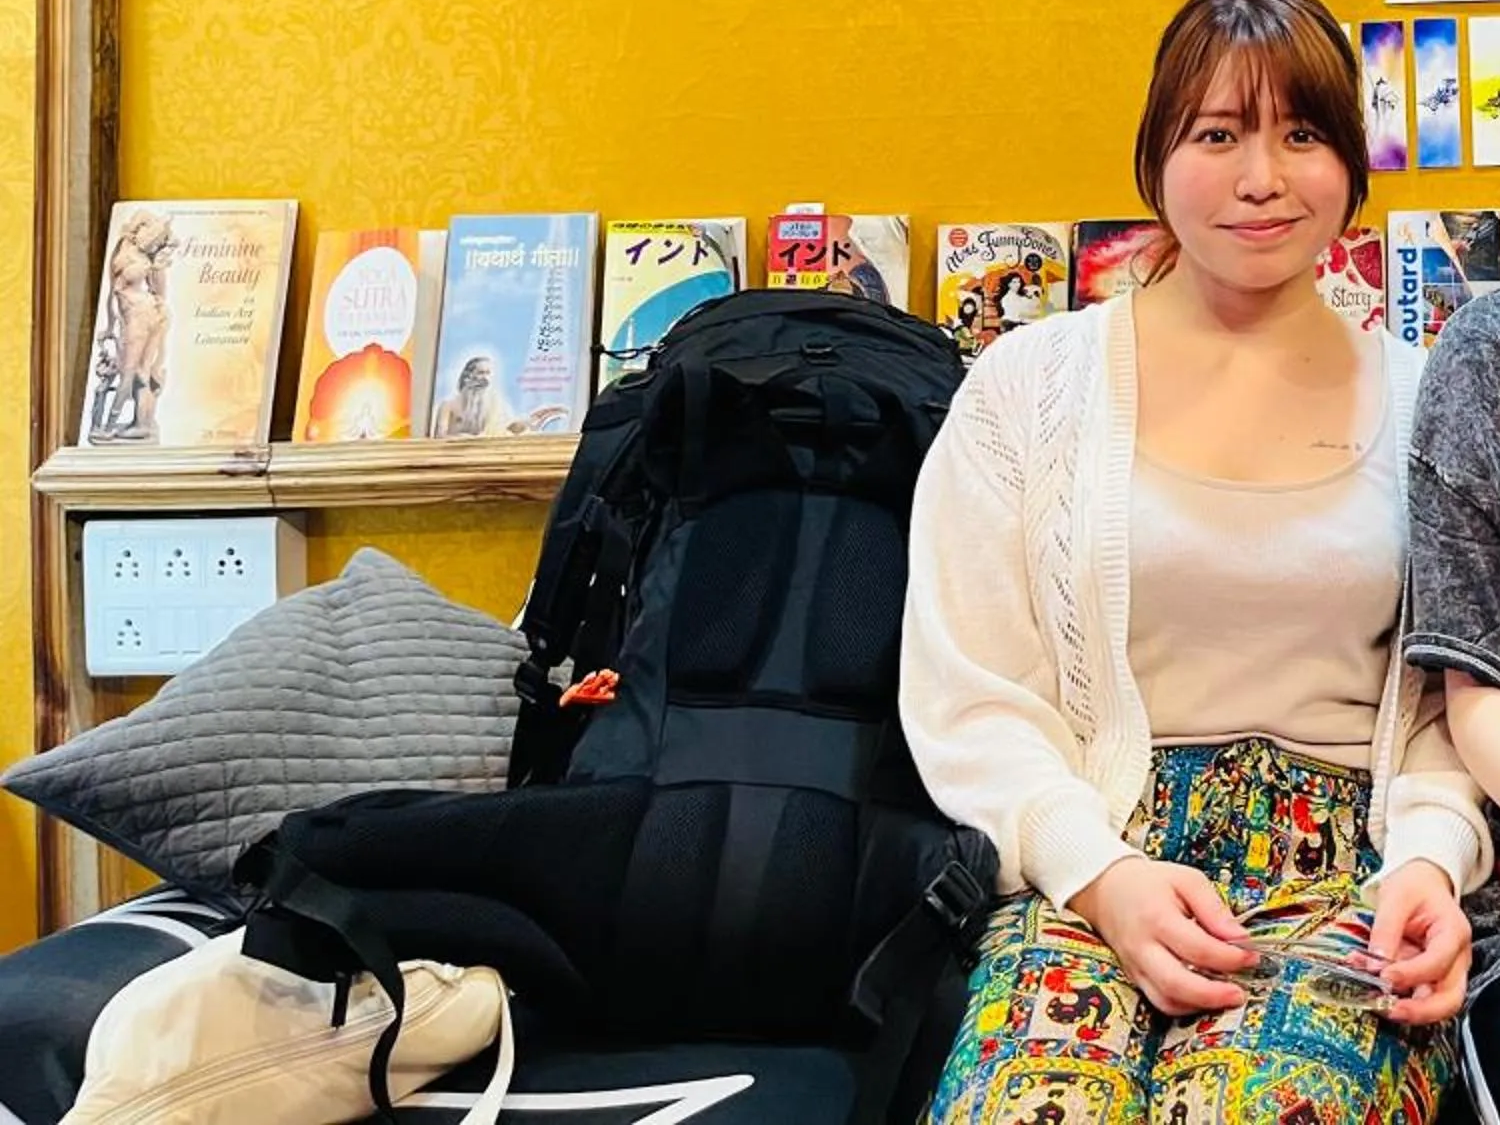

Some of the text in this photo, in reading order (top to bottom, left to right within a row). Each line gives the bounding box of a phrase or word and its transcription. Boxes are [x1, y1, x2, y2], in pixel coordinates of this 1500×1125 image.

[179, 236, 263, 259] Feminine
[778, 240, 851, 268] インド
[199, 261, 261, 290] Beauty
[1331, 285, 1372, 313] Story
[1398, 248, 1418, 347] outard
